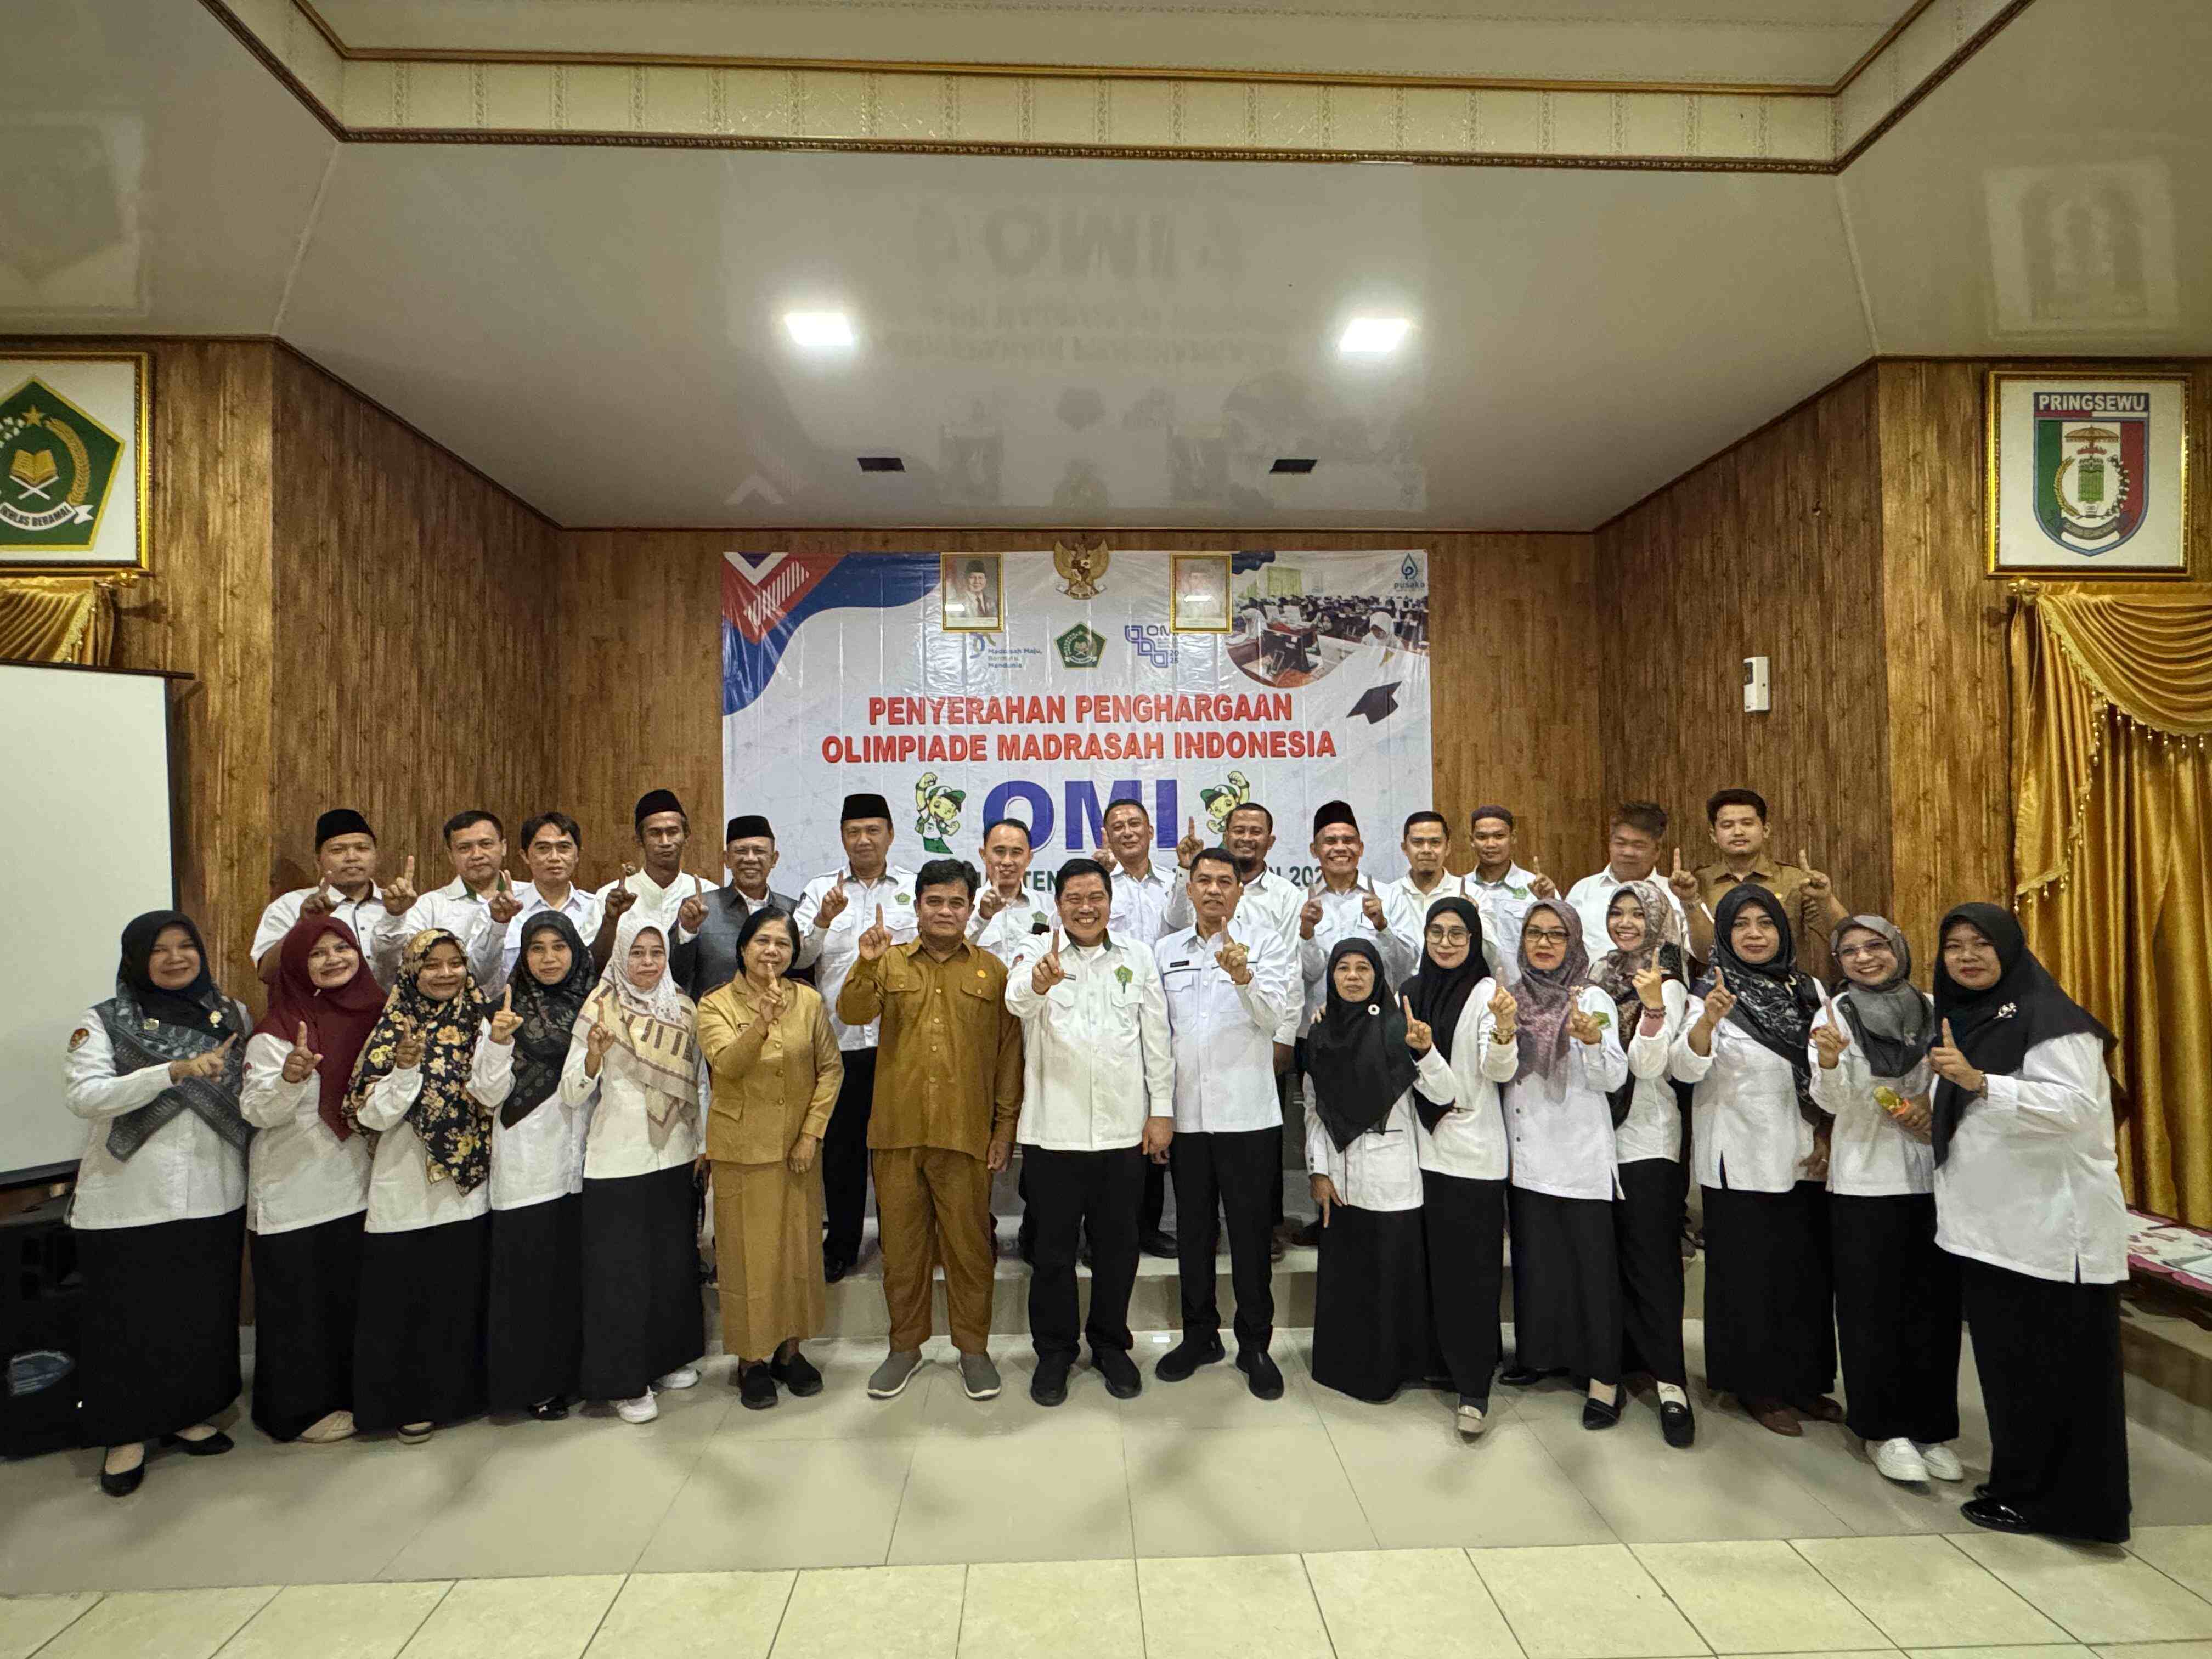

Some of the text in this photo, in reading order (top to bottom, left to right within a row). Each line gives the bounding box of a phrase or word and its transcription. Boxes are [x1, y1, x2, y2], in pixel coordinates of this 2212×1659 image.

[2038, 394, 2146, 411] PRINGSEWU
[869, 693, 1292, 725] PENYERAHAN PENGHARGAAN
[822, 731, 1335, 763] OLIMPIADE MADRASAH INDONESIA
[982, 780, 1178, 853] OMI
